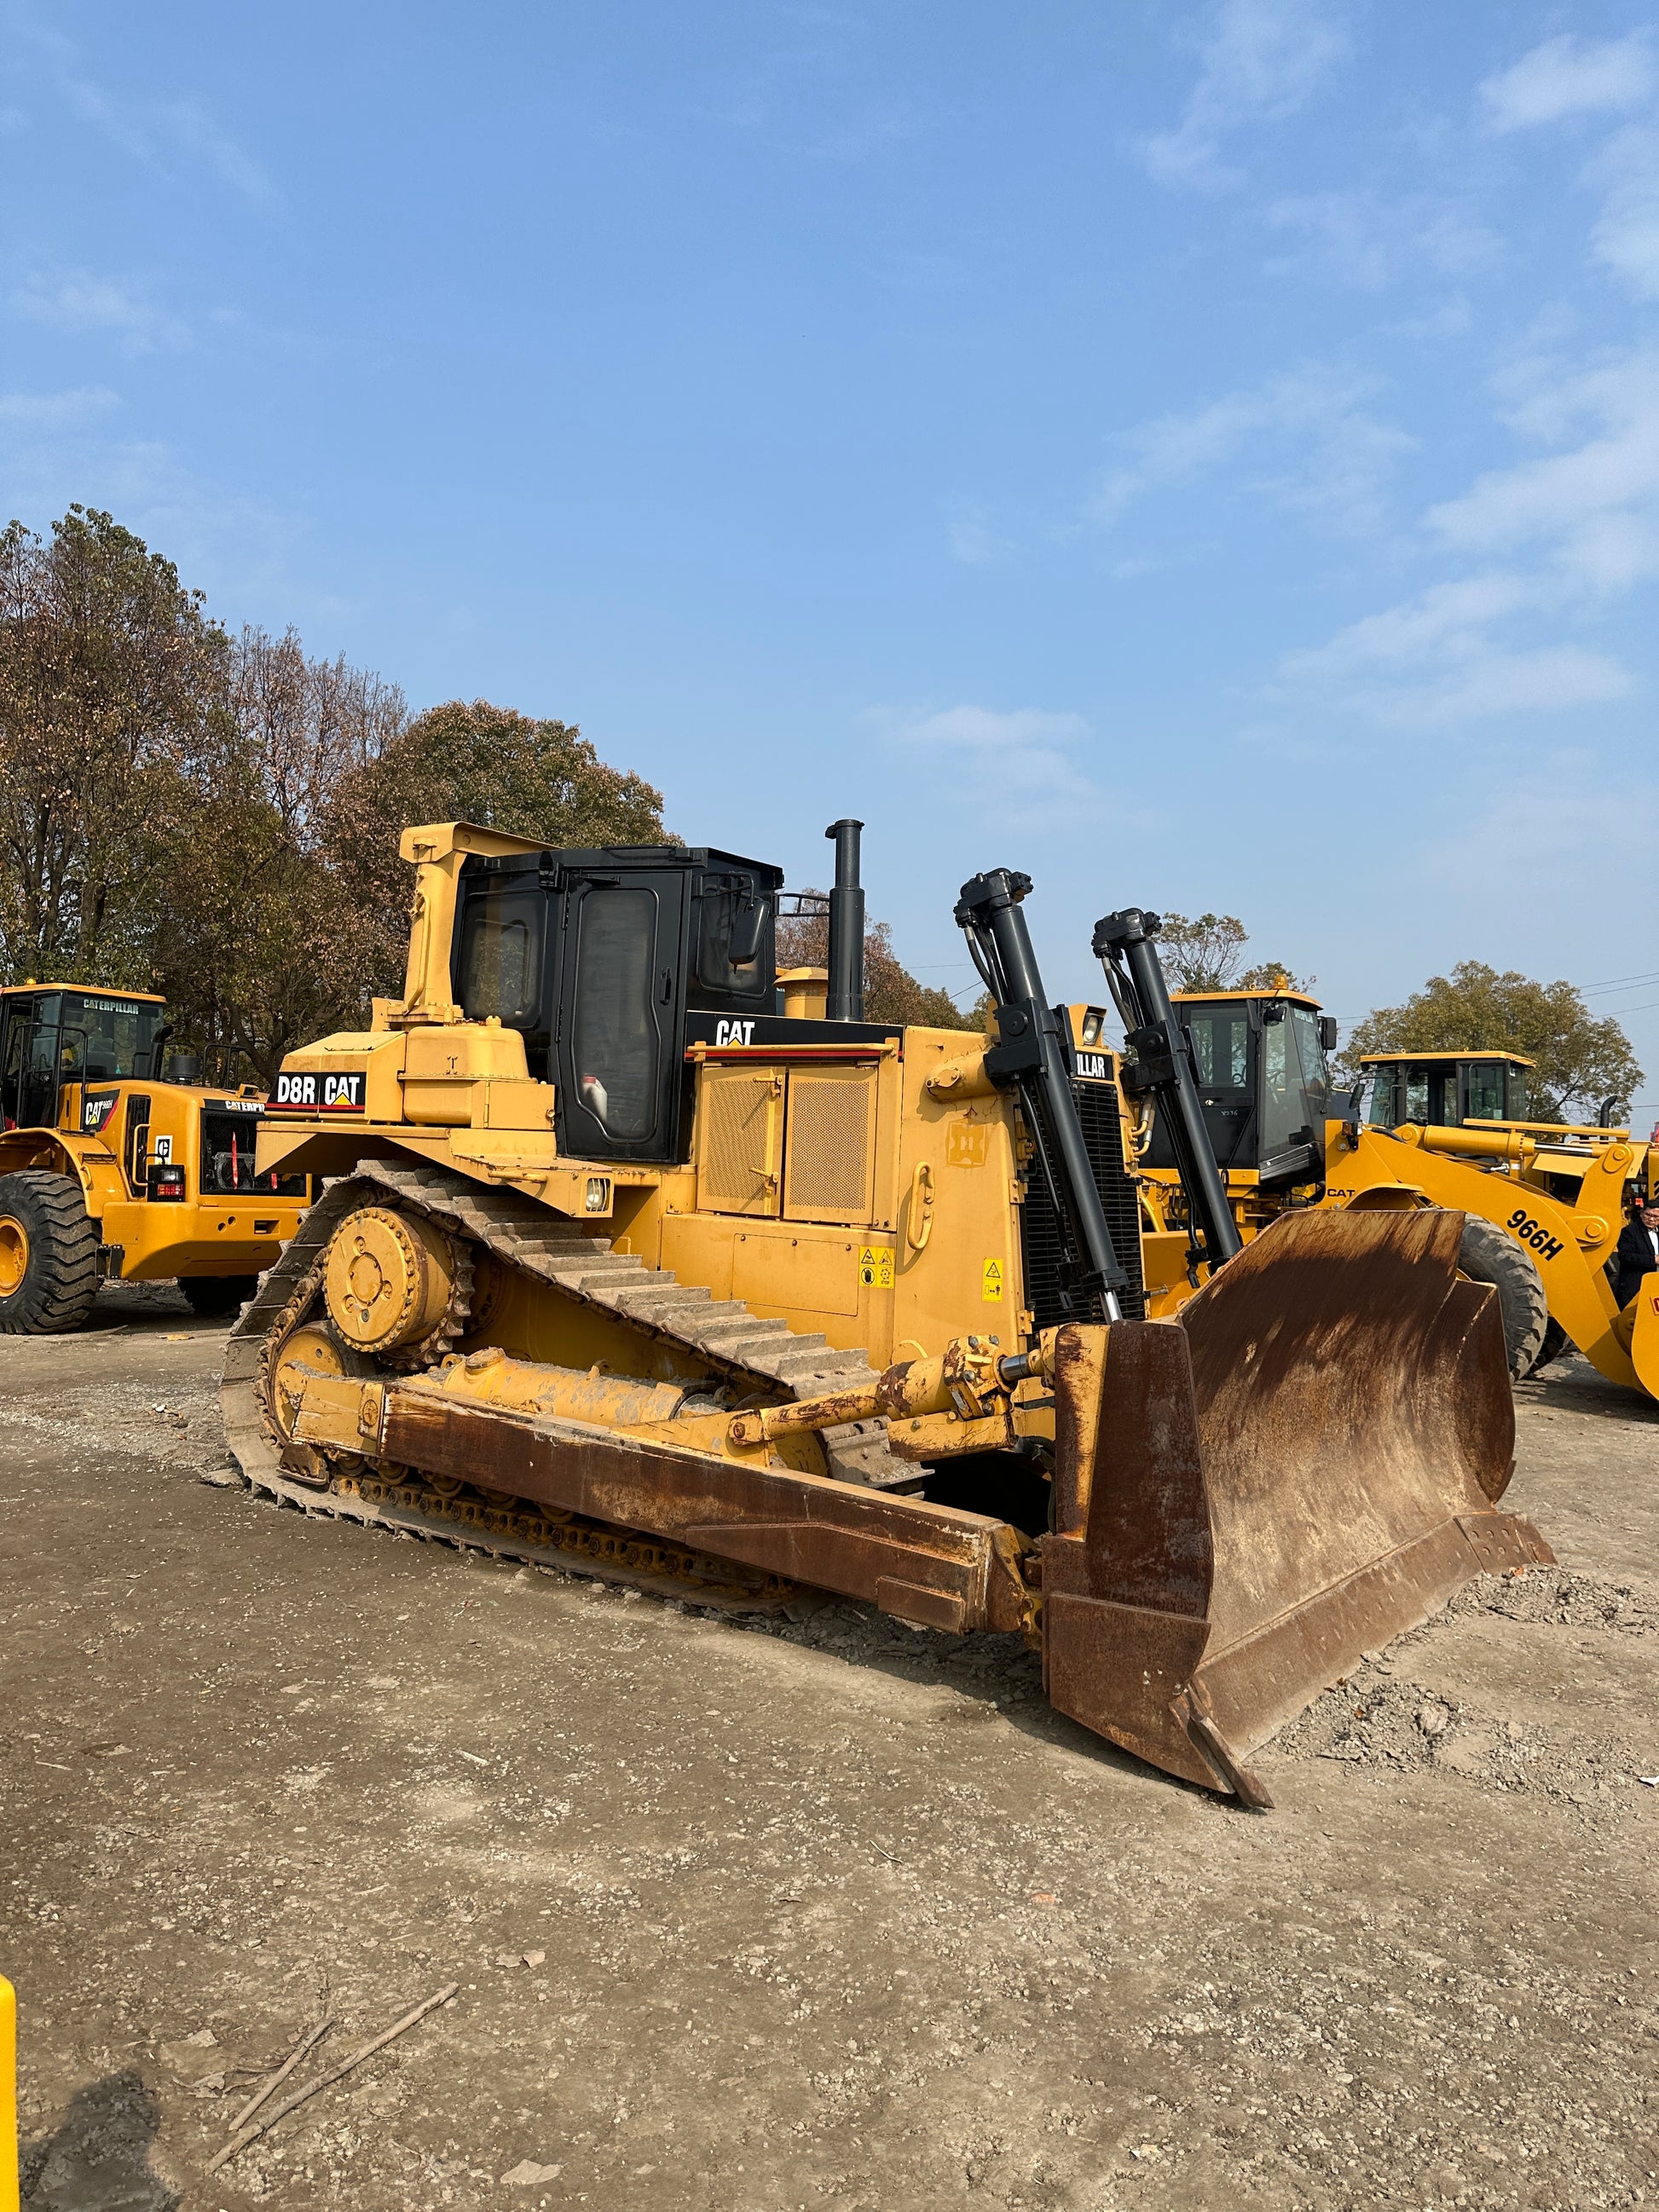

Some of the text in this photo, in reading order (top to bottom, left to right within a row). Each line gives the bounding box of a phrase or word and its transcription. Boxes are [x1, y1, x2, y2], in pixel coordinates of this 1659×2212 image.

[84, 999, 139, 1014] CATERPILLAR
[716, 1019, 755, 1046] CAT
[277, 1076, 361, 1106] D8R CAT
[85, 1101, 103, 1125] CAT
[1327, 1188, 1356, 1198] CAT
[1506, 1209, 1564, 1262] 966H
